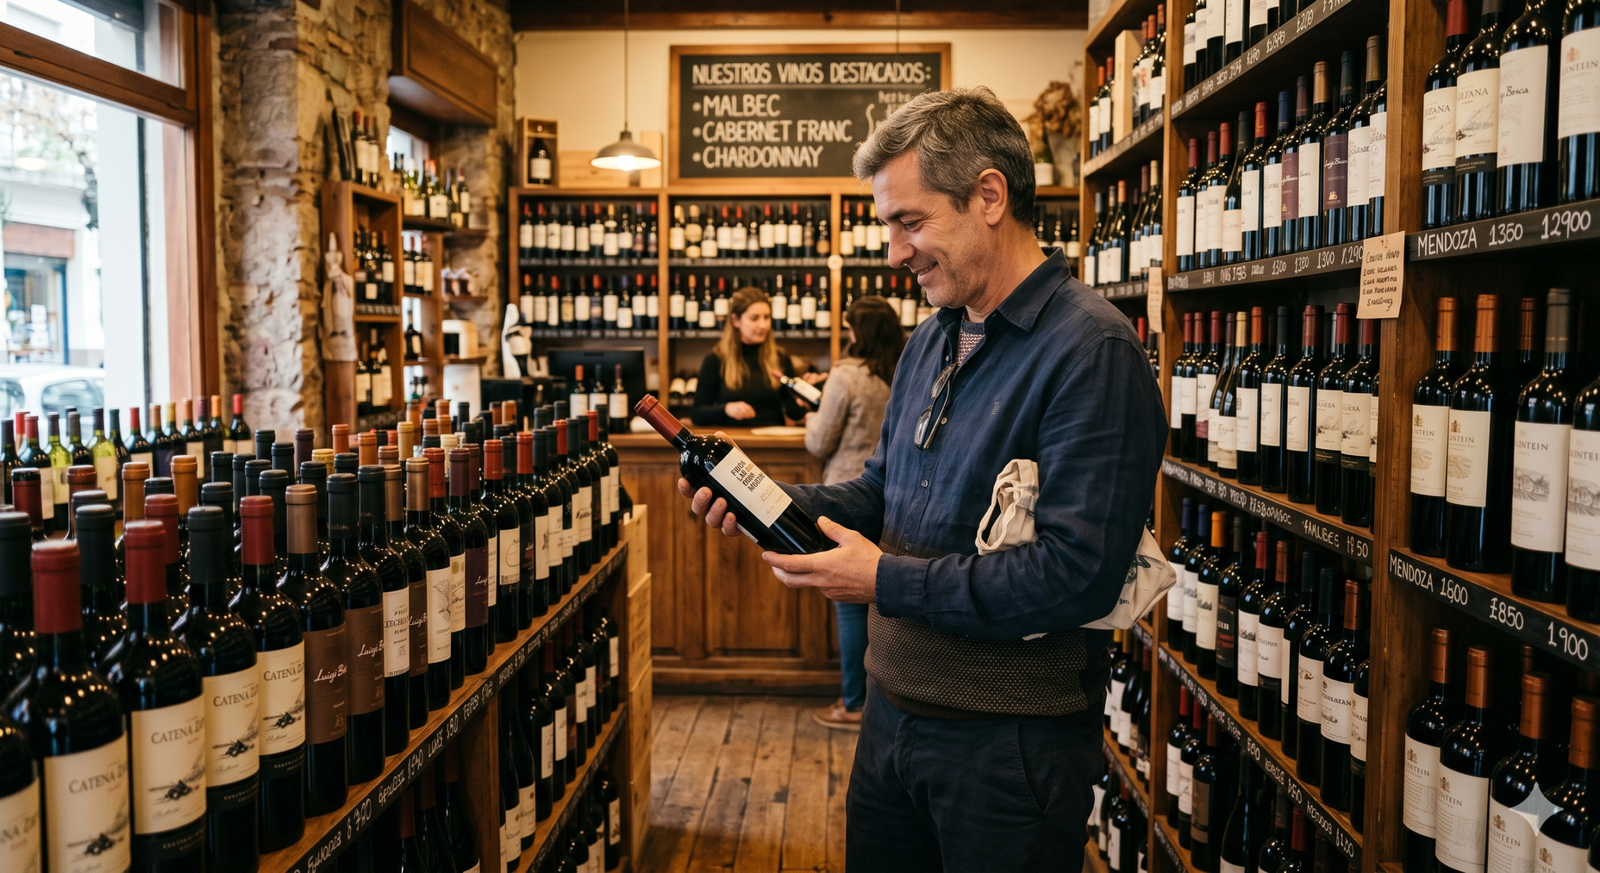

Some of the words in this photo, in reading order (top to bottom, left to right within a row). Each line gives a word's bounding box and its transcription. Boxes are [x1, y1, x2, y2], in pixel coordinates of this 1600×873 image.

[692, 62, 772, 85] NUESTROS
[777, 62, 825, 84] VINOS
[830, 61, 932, 84] DESTACADOS:
[703, 94, 781, 117] MALBEC
[702, 120, 793, 144] CABERNET
[797, 119, 853, 143] FRANC
[702, 145, 824, 169] CHARDONNAY
[1417, 226, 1478, 258] MENDOZA
[1540, 210, 1592, 240] 12900
[1389, 554, 1434, 593] MENDOZA
[263, 665, 297, 682] CATENA
[212, 690, 250, 708] CATENA
[150, 724, 192, 745] CATENA
[68, 769, 117, 795] CATENA
